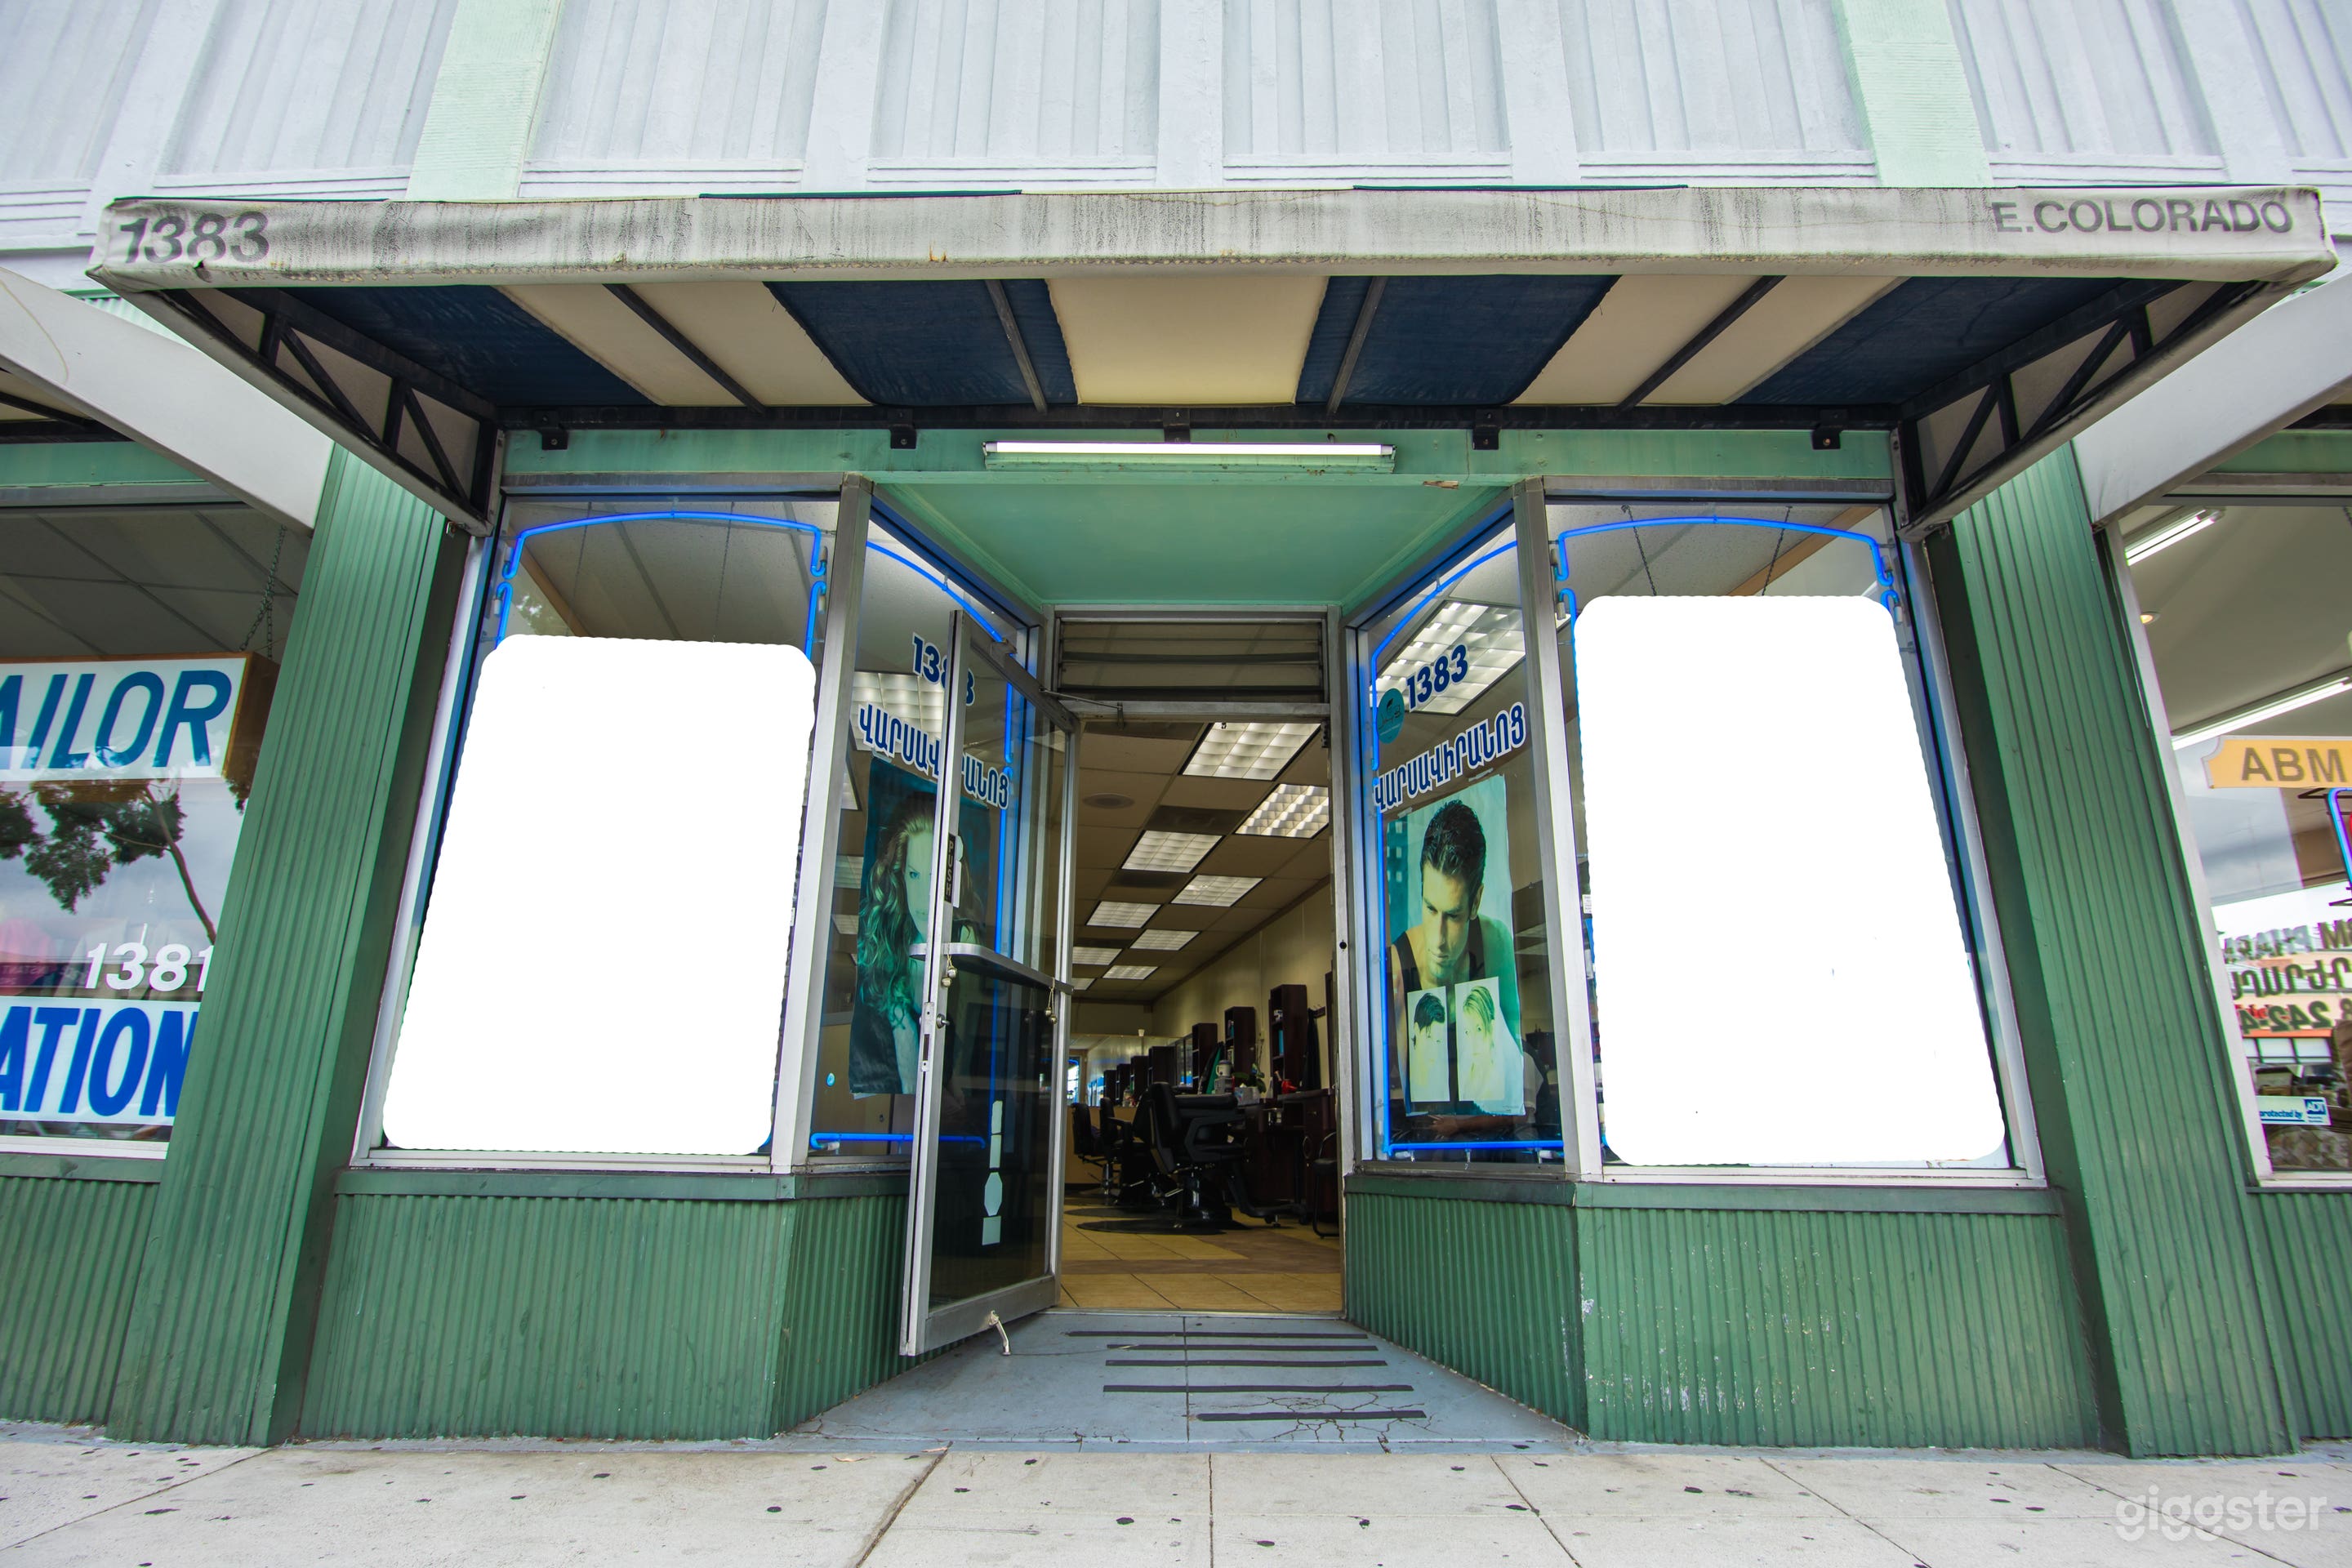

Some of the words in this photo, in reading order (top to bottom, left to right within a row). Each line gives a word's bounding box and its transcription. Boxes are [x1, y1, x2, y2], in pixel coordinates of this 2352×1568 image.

[120, 211, 270, 264] 1383
[912, 633, 975, 706] 133
[1406, 644, 1468, 711] 1383
[2242, 747, 2348, 782] ABM
[946, 840, 954, 896] PUSH
[85, 942, 214, 991] 1381
[0, 1006, 199, 1116] ATION
[2294, 1110, 2303, 1120] by
[2305, 1101, 2326, 1114] ADT
